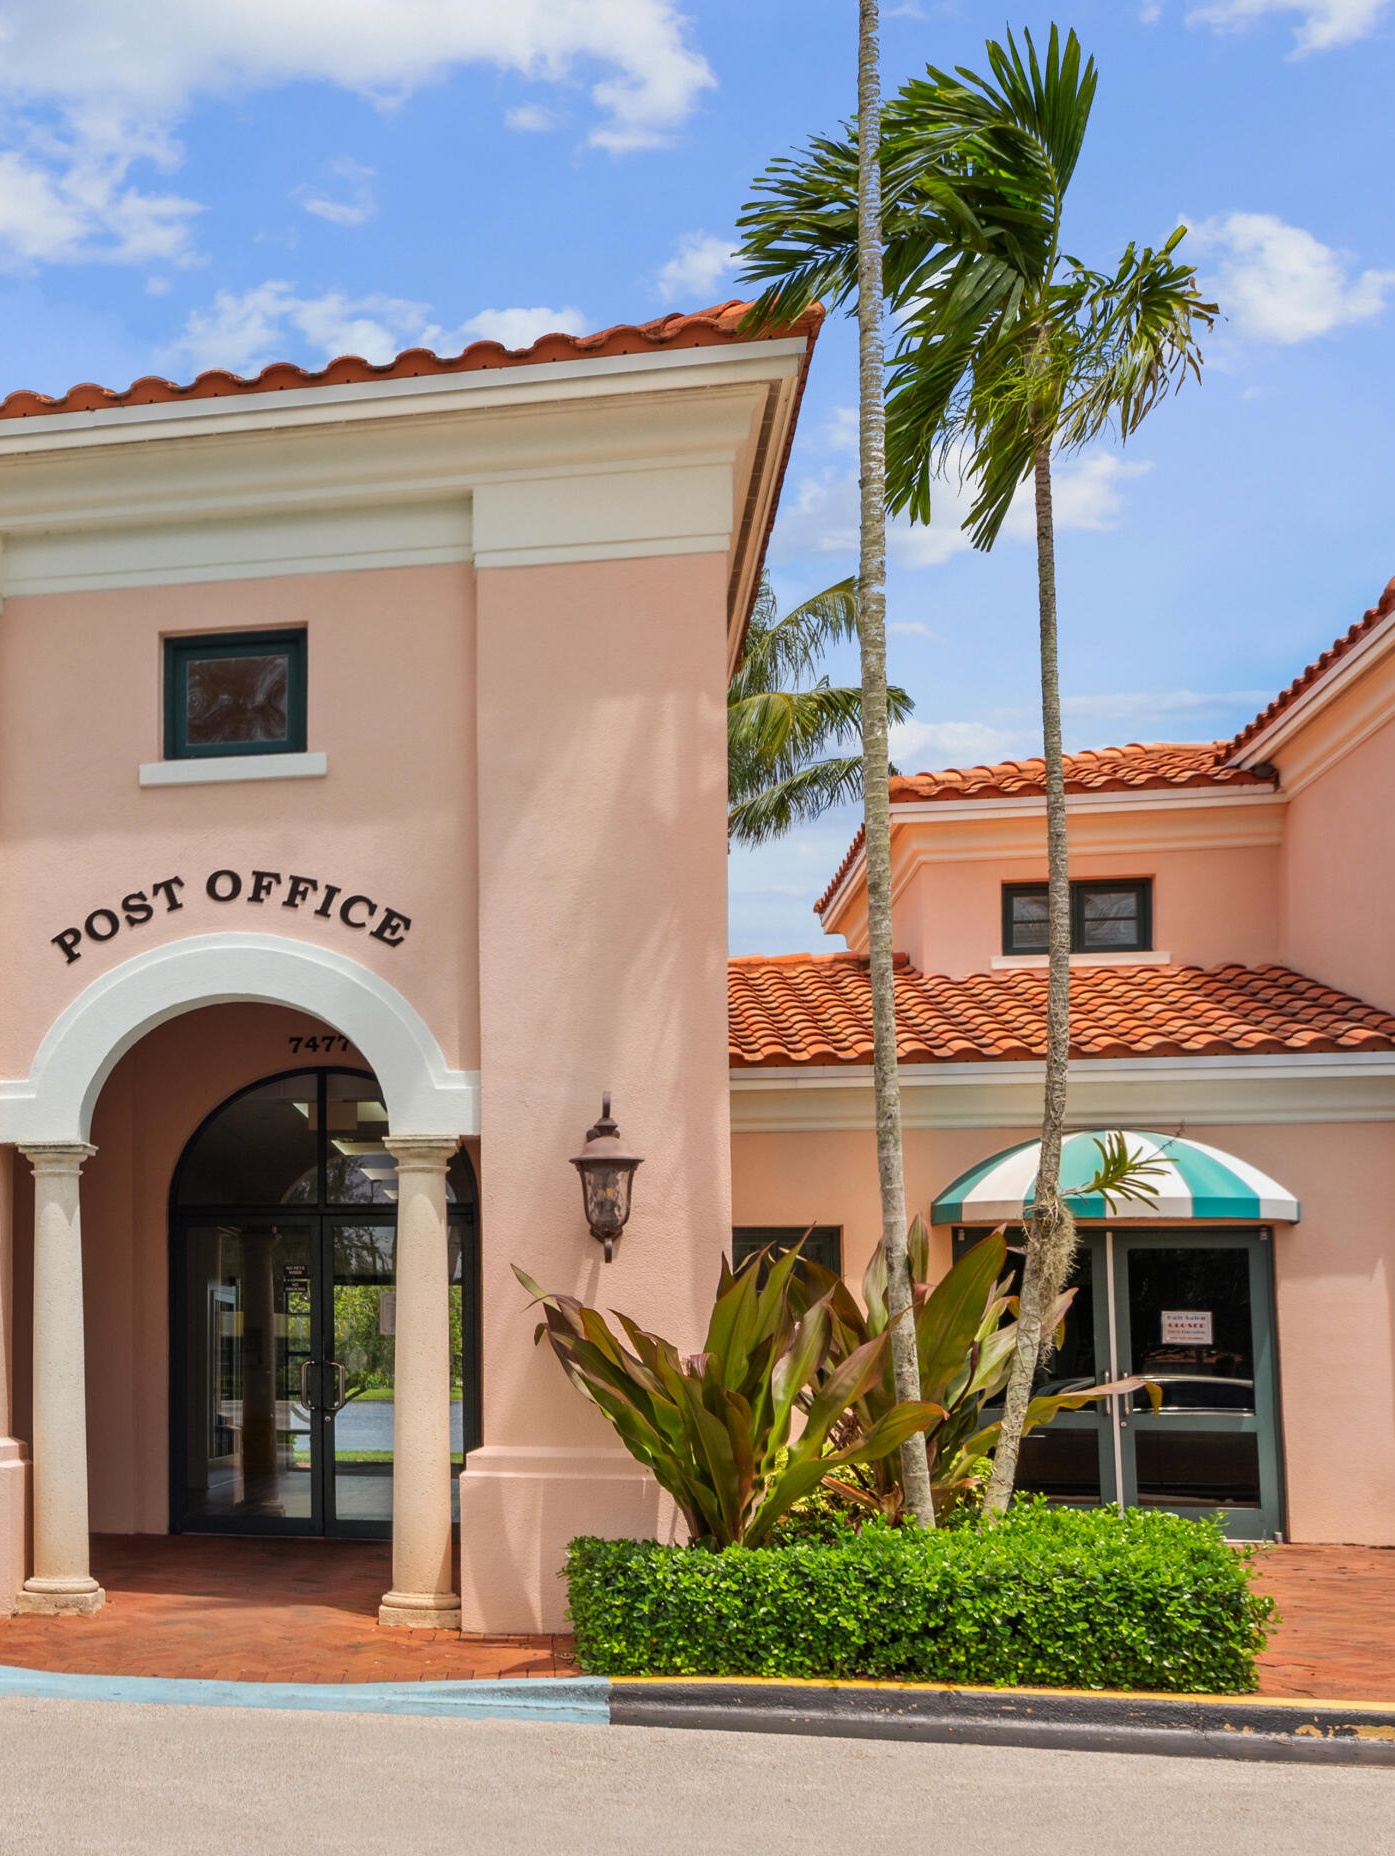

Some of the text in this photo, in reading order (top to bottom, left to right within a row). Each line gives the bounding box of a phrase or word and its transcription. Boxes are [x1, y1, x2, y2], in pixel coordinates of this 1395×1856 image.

[51, 869, 412, 964] POST OFFICE
[288, 1035, 350, 1054] 7477
